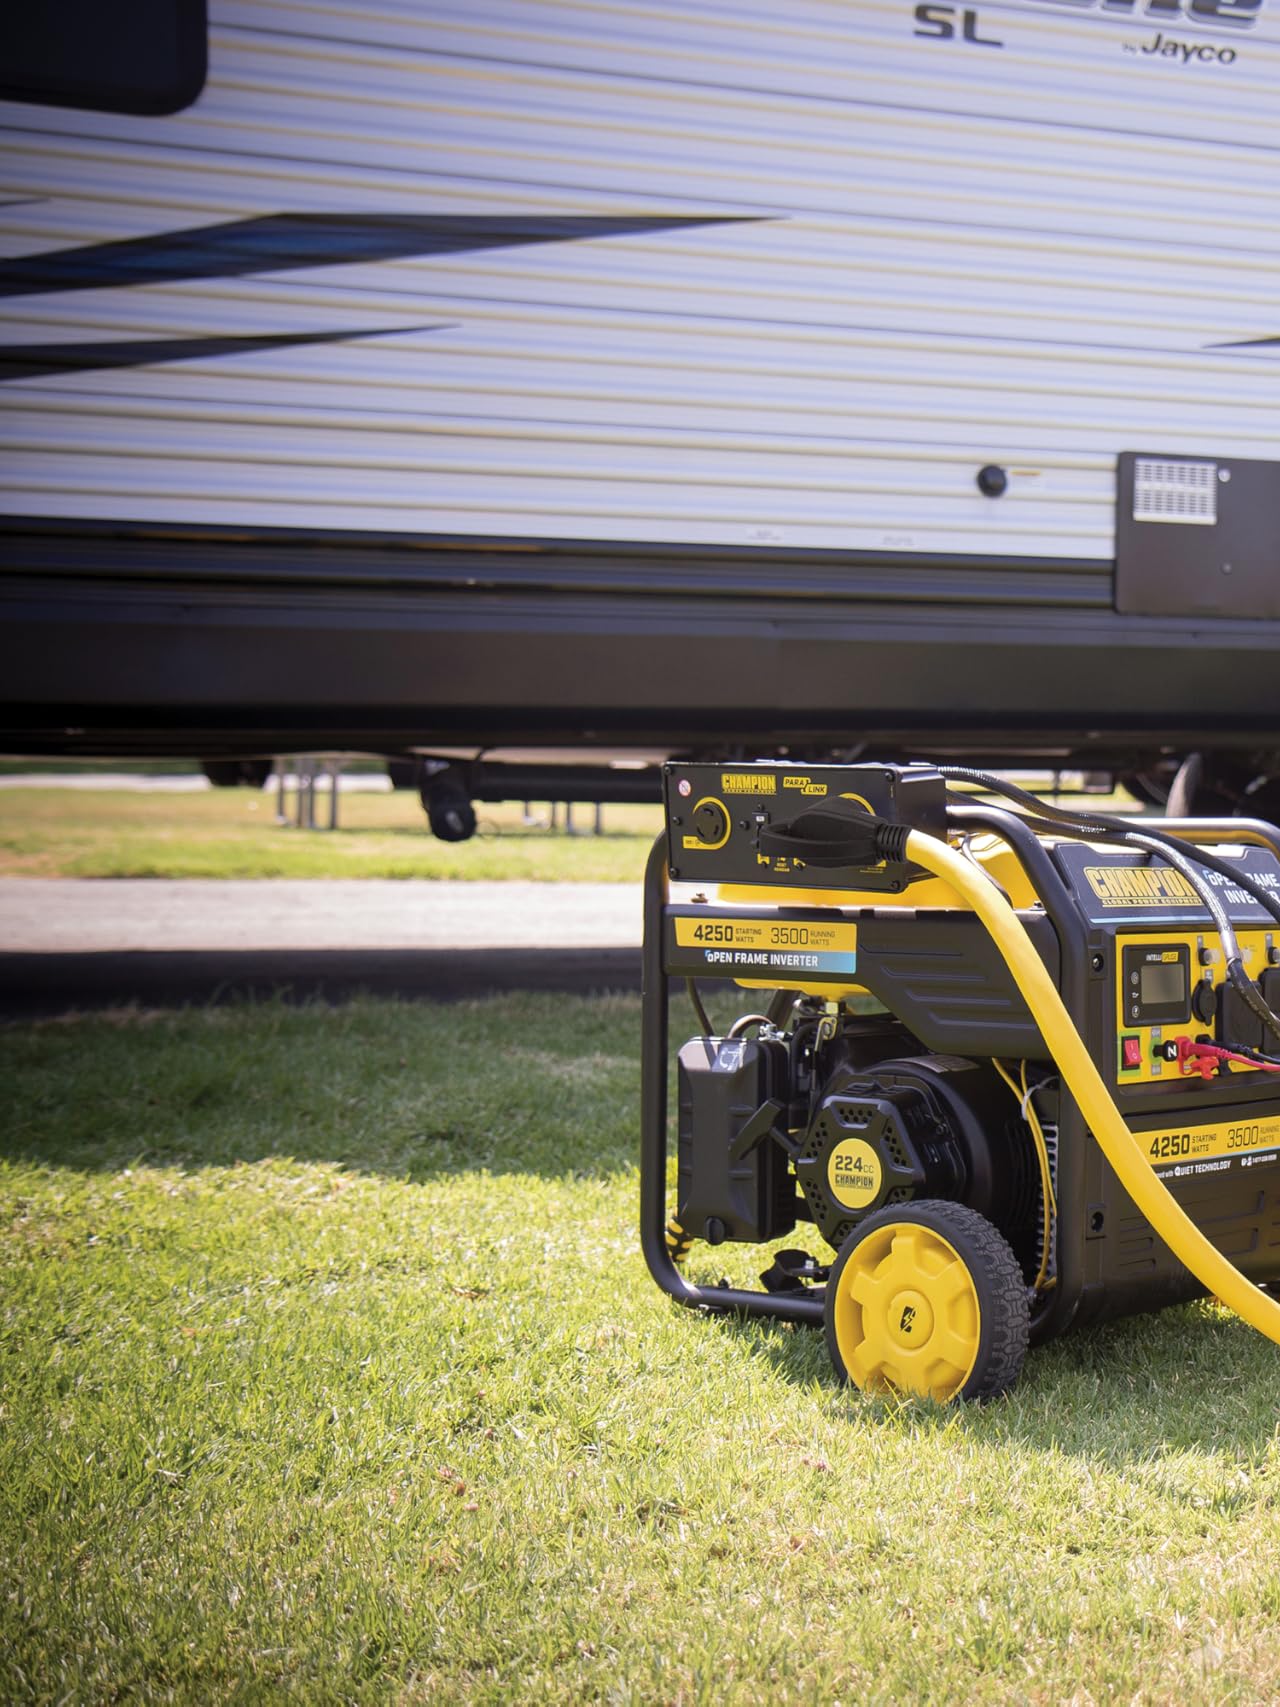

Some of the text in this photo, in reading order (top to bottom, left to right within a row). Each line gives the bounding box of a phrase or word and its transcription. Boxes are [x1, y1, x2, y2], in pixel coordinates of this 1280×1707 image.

[914, 4, 1004, 48] SL
[1141, 32, 1237, 65] Jayco
[722, 774, 776, 790] CHAMPION
[808, 785, 825, 793] LINK
[693, 924, 809, 945] 4250 3500
[735, 927, 762, 936] STARTING
[734, 953, 768, 965] FRAME
[770, 954, 818, 967] INVERTER
[1149, 1125, 1260, 1158] 4250 3500
[1191, 1133, 1217, 1144] STARTING
[1191, 1144, 1210, 1153] WATTS
[1174, 1165, 1194, 1177] QUIET
[1195, 1159, 1232, 1174] TECHNOLOGY
[835, 1174, 874, 1187] CHAMPION
